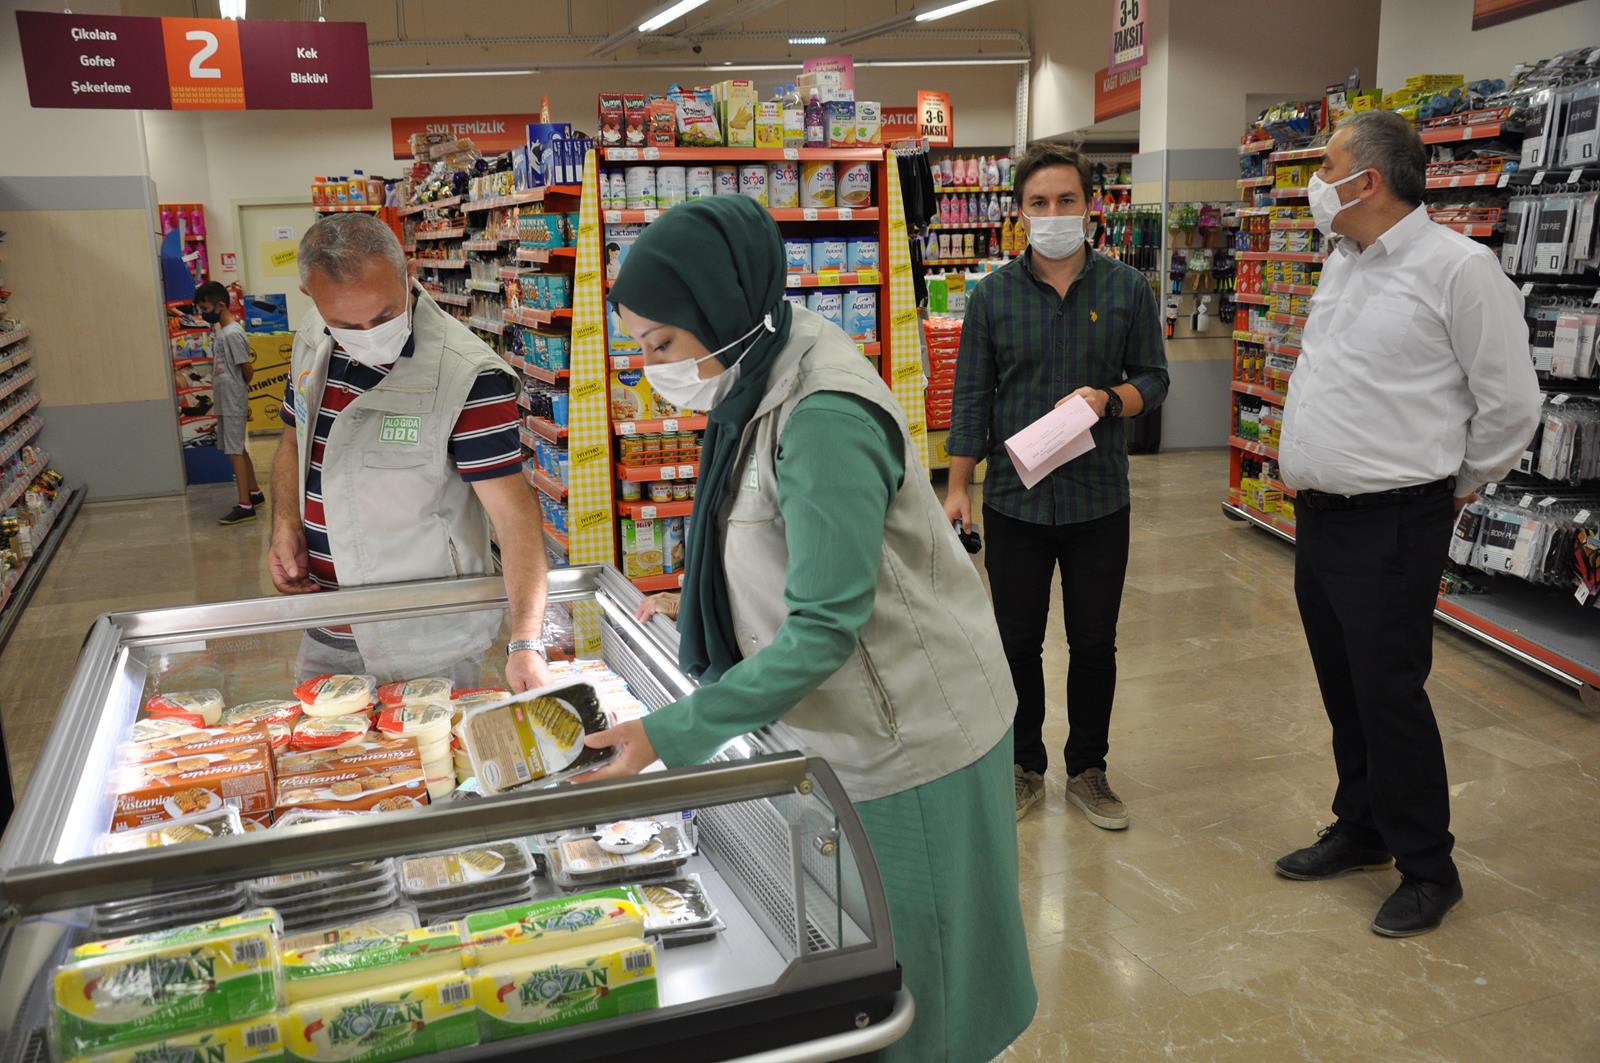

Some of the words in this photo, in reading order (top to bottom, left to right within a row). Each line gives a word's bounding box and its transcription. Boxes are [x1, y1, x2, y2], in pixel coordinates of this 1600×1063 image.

[71, 28, 117, 41] Çikolata
[1114, 21, 1144, 54] TAKSİT
[185, 30, 221, 78] 2
[297, 47, 318, 59] Kek
[80, 54, 116, 67] Gofret
[290, 72, 329, 84] Bisküvi
[71, 81, 131, 94] Şekerleme
[926, 110, 943, 123] 3-6
[426, 123, 449, 135] SIVI
[451, 120, 505, 134] TEMİZLİK
[921, 124, 947, 136] TAKSİT
[248, 373, 289, 394] İTİRİYO
[115, 795, 172, 812] Pastamia
[520, 967, 609, 1005] KOZAN
